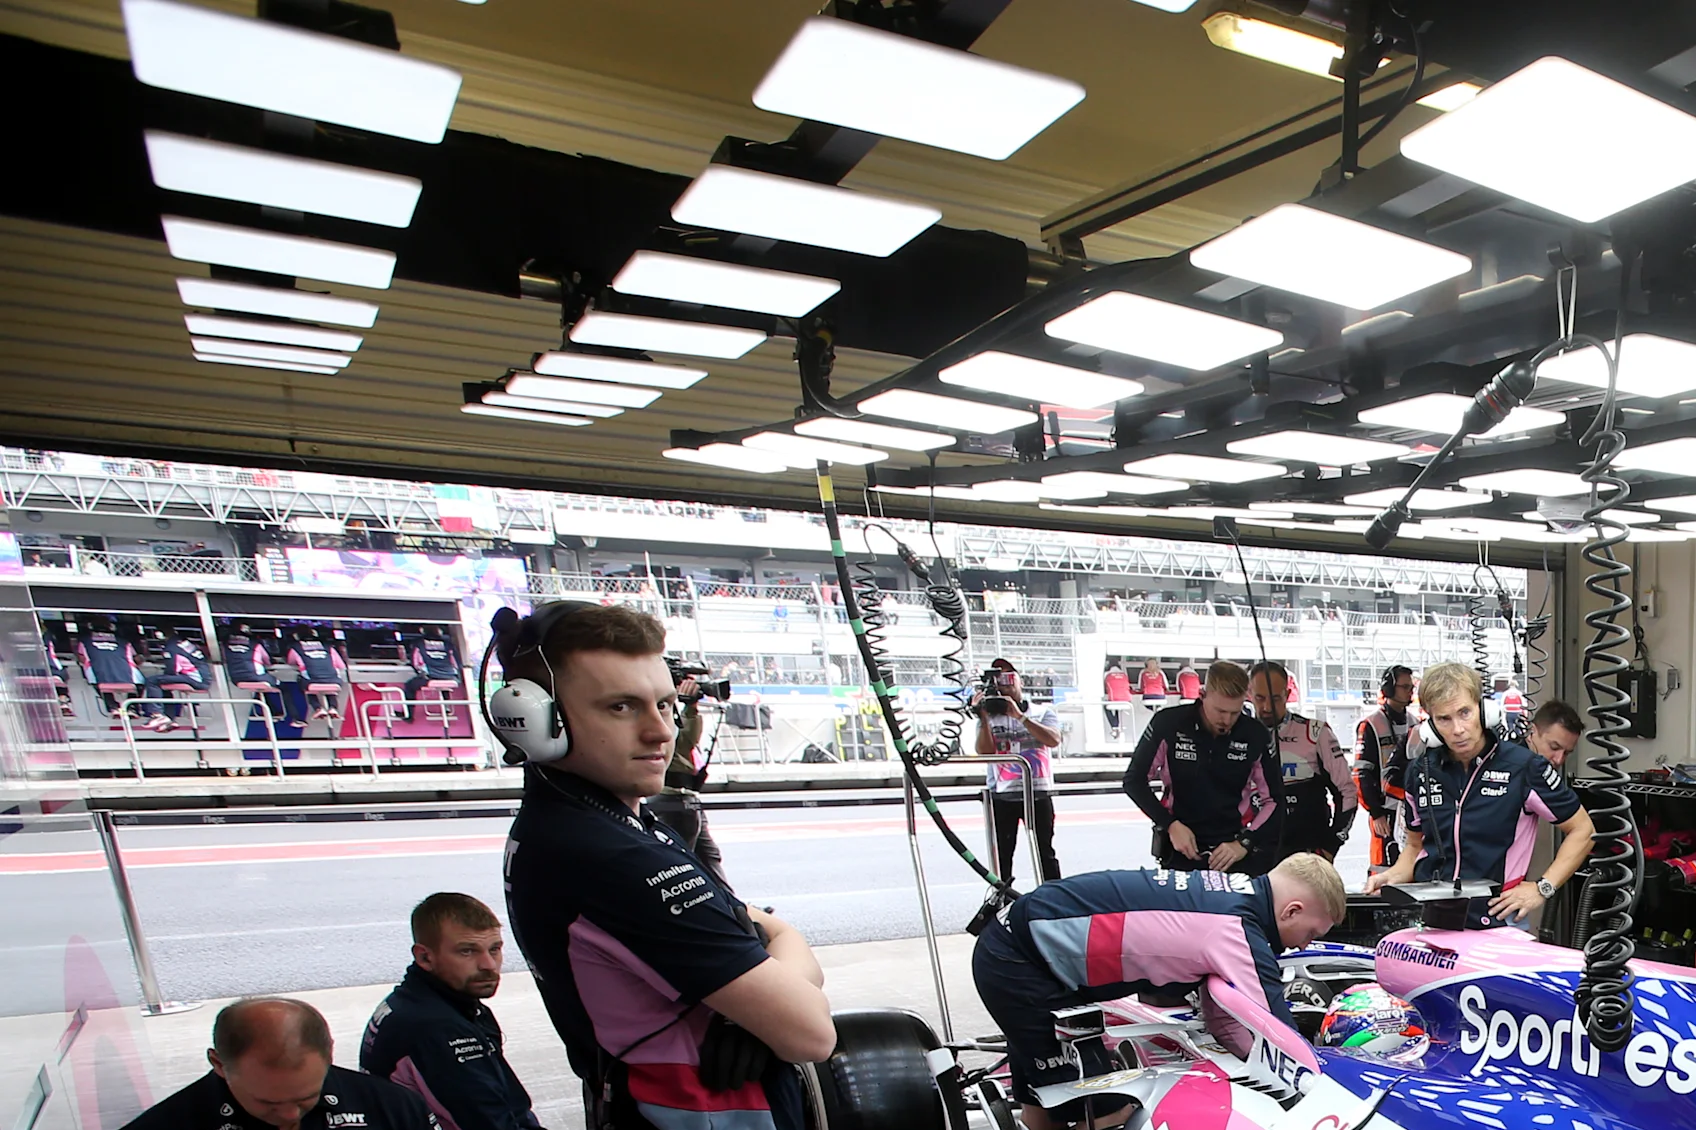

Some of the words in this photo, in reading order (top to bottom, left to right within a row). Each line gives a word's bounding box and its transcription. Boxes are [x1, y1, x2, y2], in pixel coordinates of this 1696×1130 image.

[500, 717, 526, 729] BWT
[1175, 742, 1197, 751] NEC
[1227, 752, 1246, 761] Claro
[1490, 771, 1511, 781] BWT
[1481, 786, 1503, 796] Claro
[647, 862, 695, 888] infinitum
[661, 875, 707, 902] Acronis
[1377, 940, 1459, 970] BOMBARDIER
[1283, 981, 1327, 1008] ZERO
[333, 1113, 366, 1125] BWT
